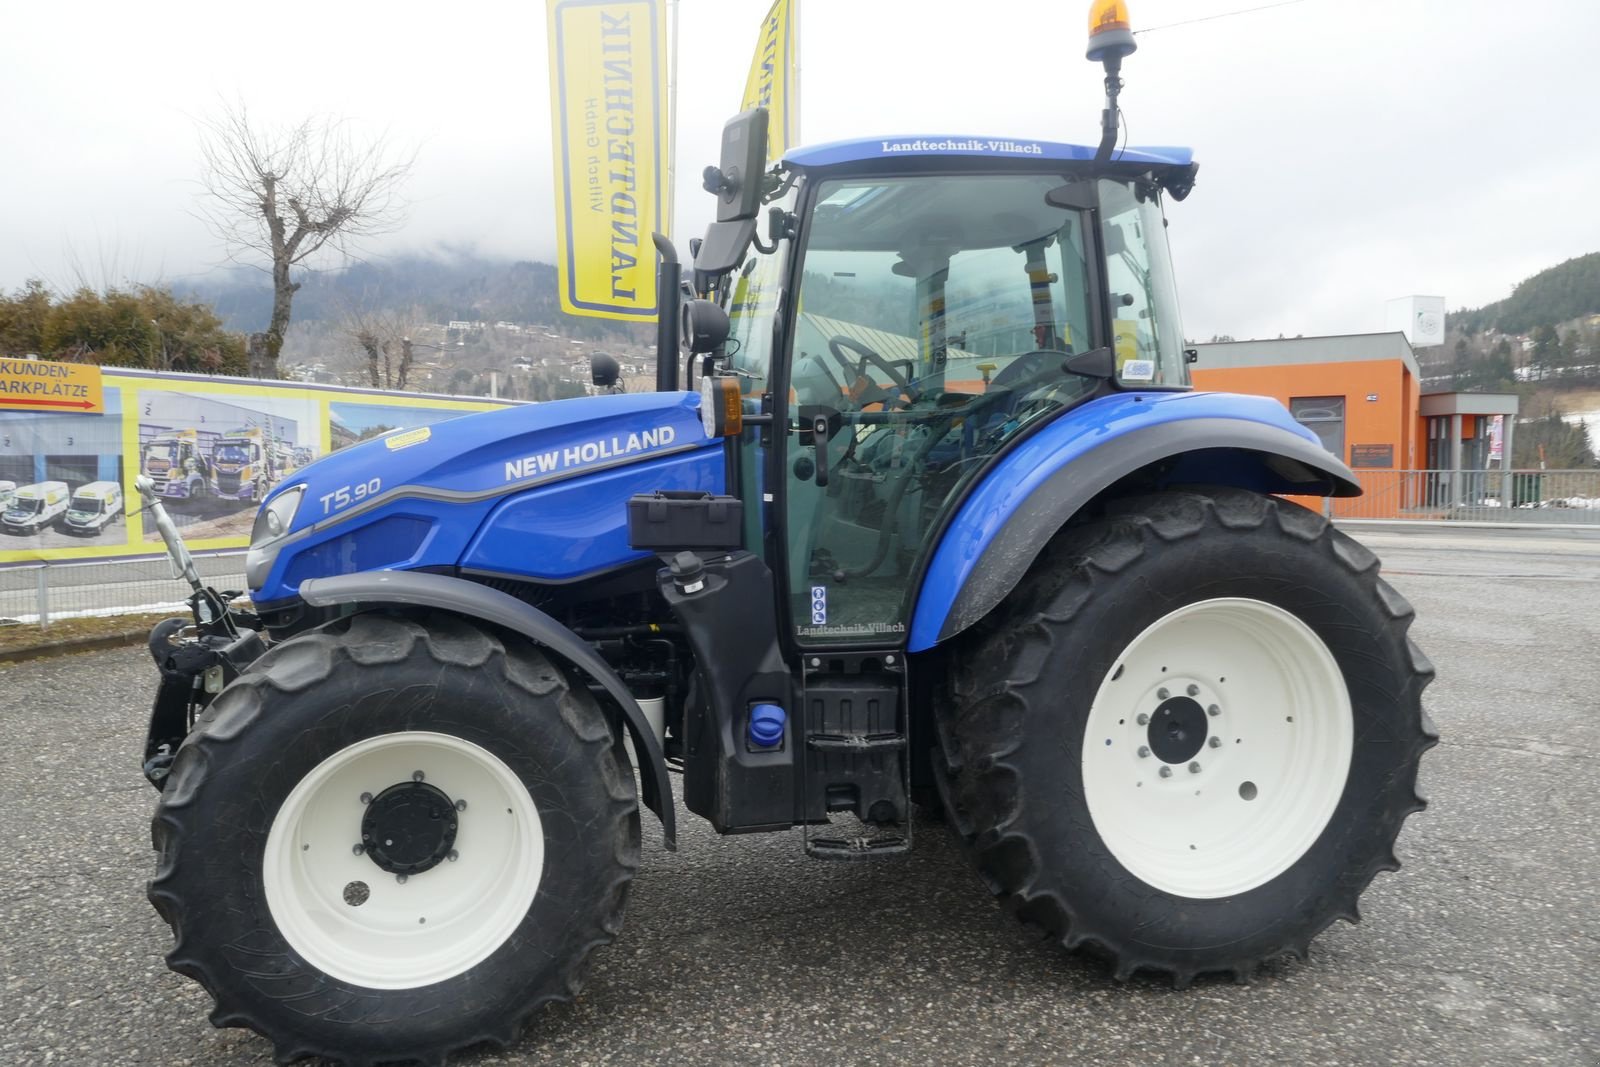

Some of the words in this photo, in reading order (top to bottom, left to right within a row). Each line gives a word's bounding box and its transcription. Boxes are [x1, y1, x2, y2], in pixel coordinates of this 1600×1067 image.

[882, 139, 1042, 154] Landtechnik-Villach
[0, 361, 76, 378] KUNDEN-
[0, 379, 88, 397] ARKPLÄTZE
[505, 451, 559, 481] NEW
[563, 426, 675, 467] HOLLAND
[319, 477, 381, 514] T5.90
[796, 622, 905, 636] Landtechnik-Villach
